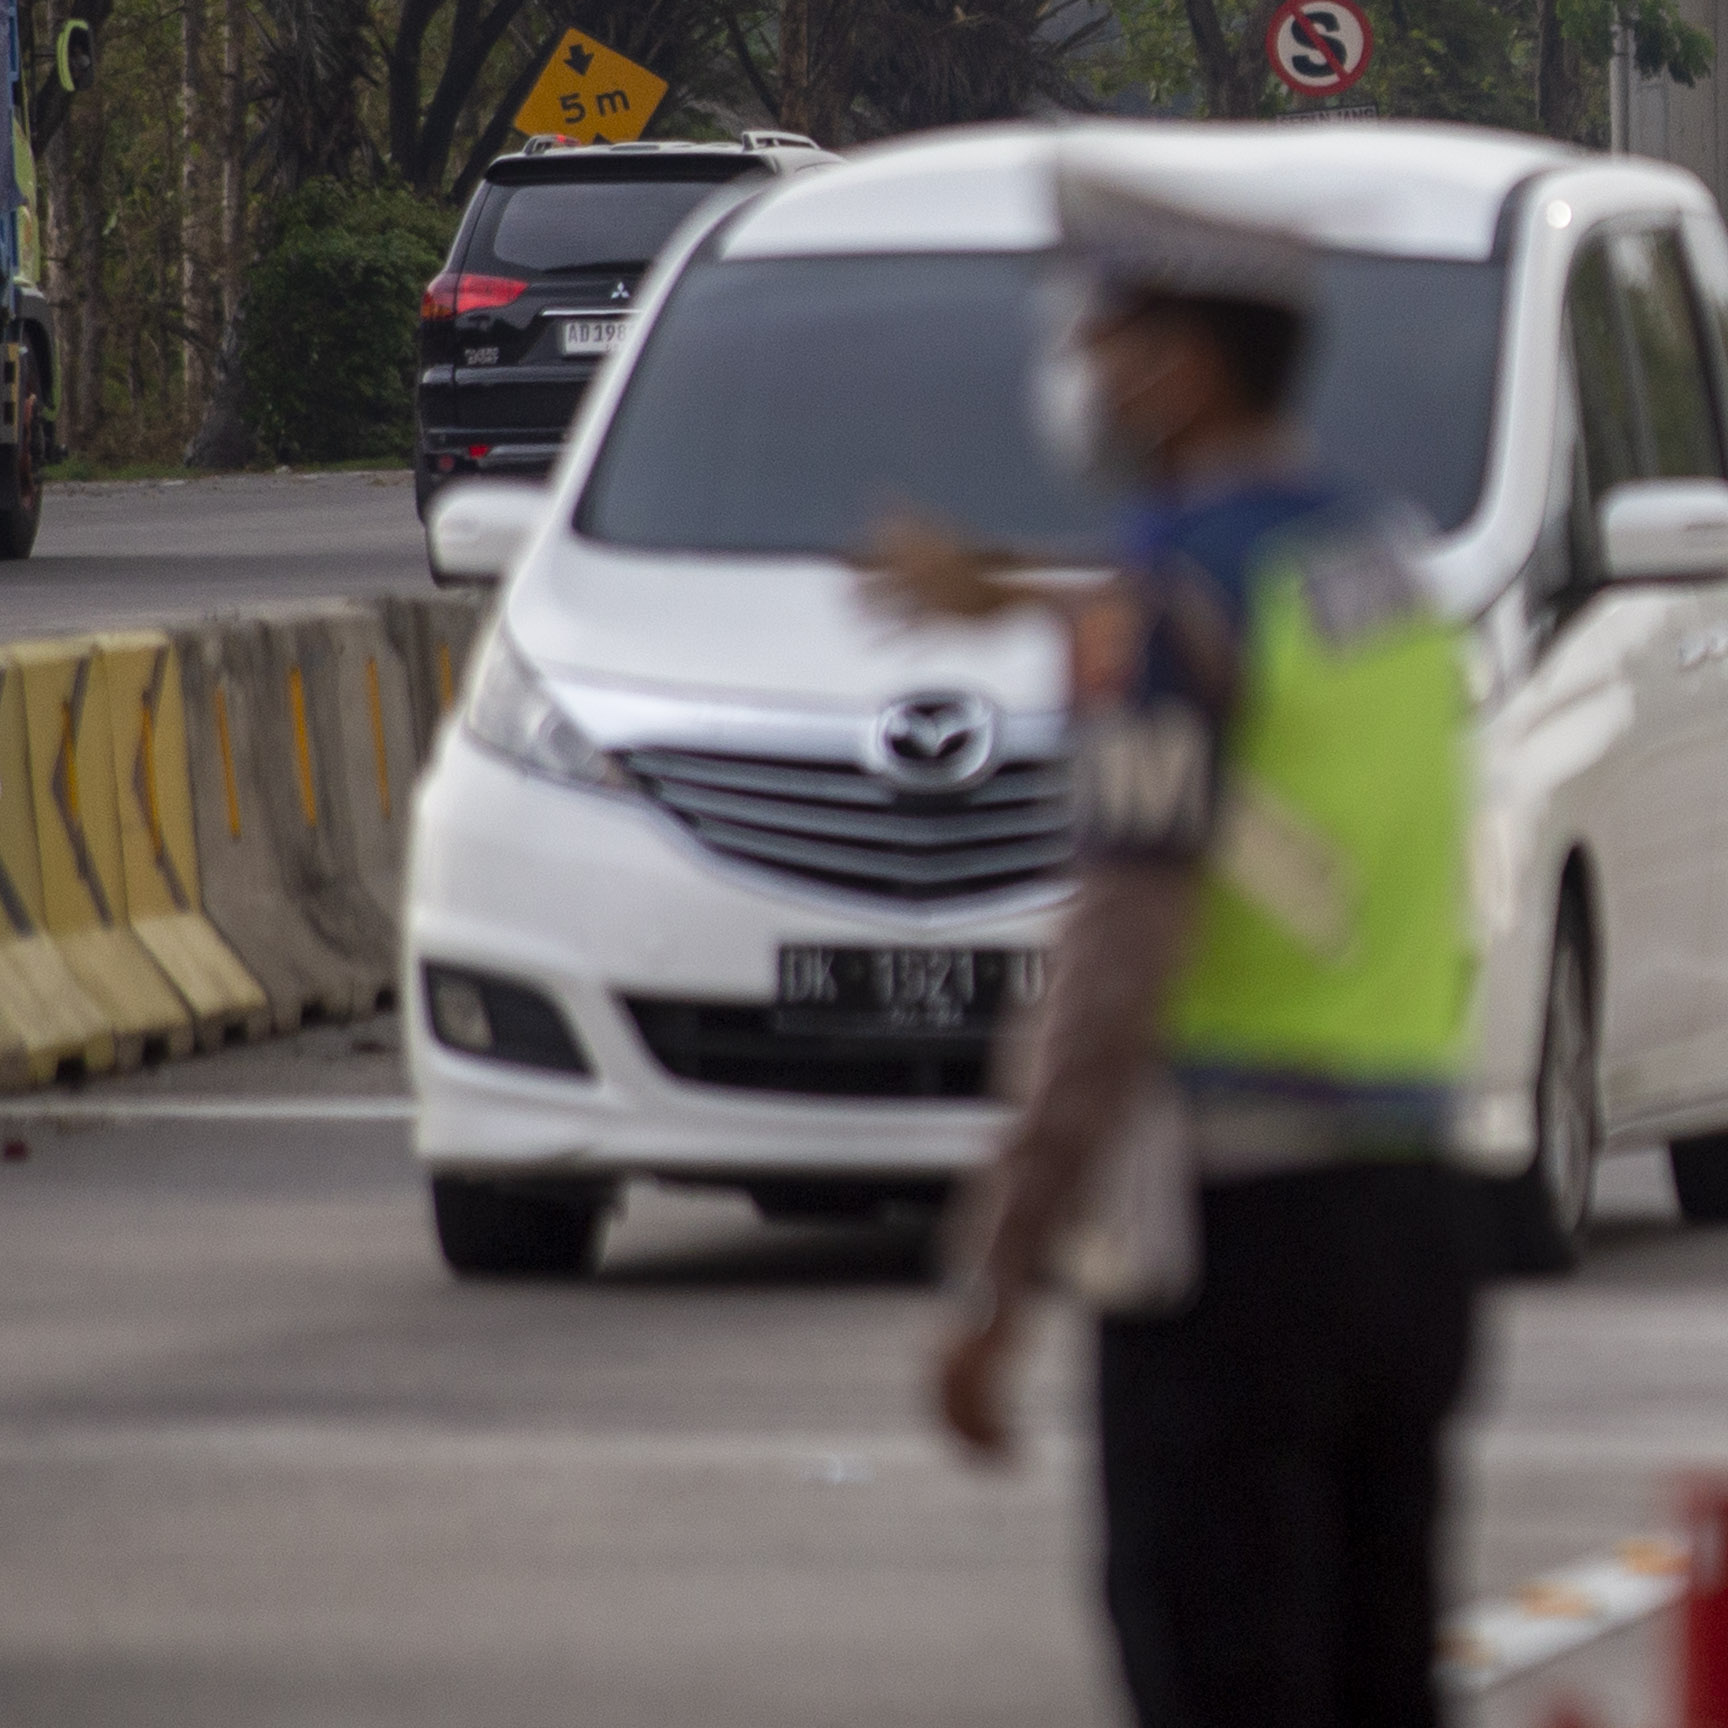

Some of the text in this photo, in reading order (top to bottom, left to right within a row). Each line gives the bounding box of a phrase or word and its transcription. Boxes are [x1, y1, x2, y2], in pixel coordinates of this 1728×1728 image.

[559, 89, 631, 125] 5 m
[567, 324, 590, 342] AD
